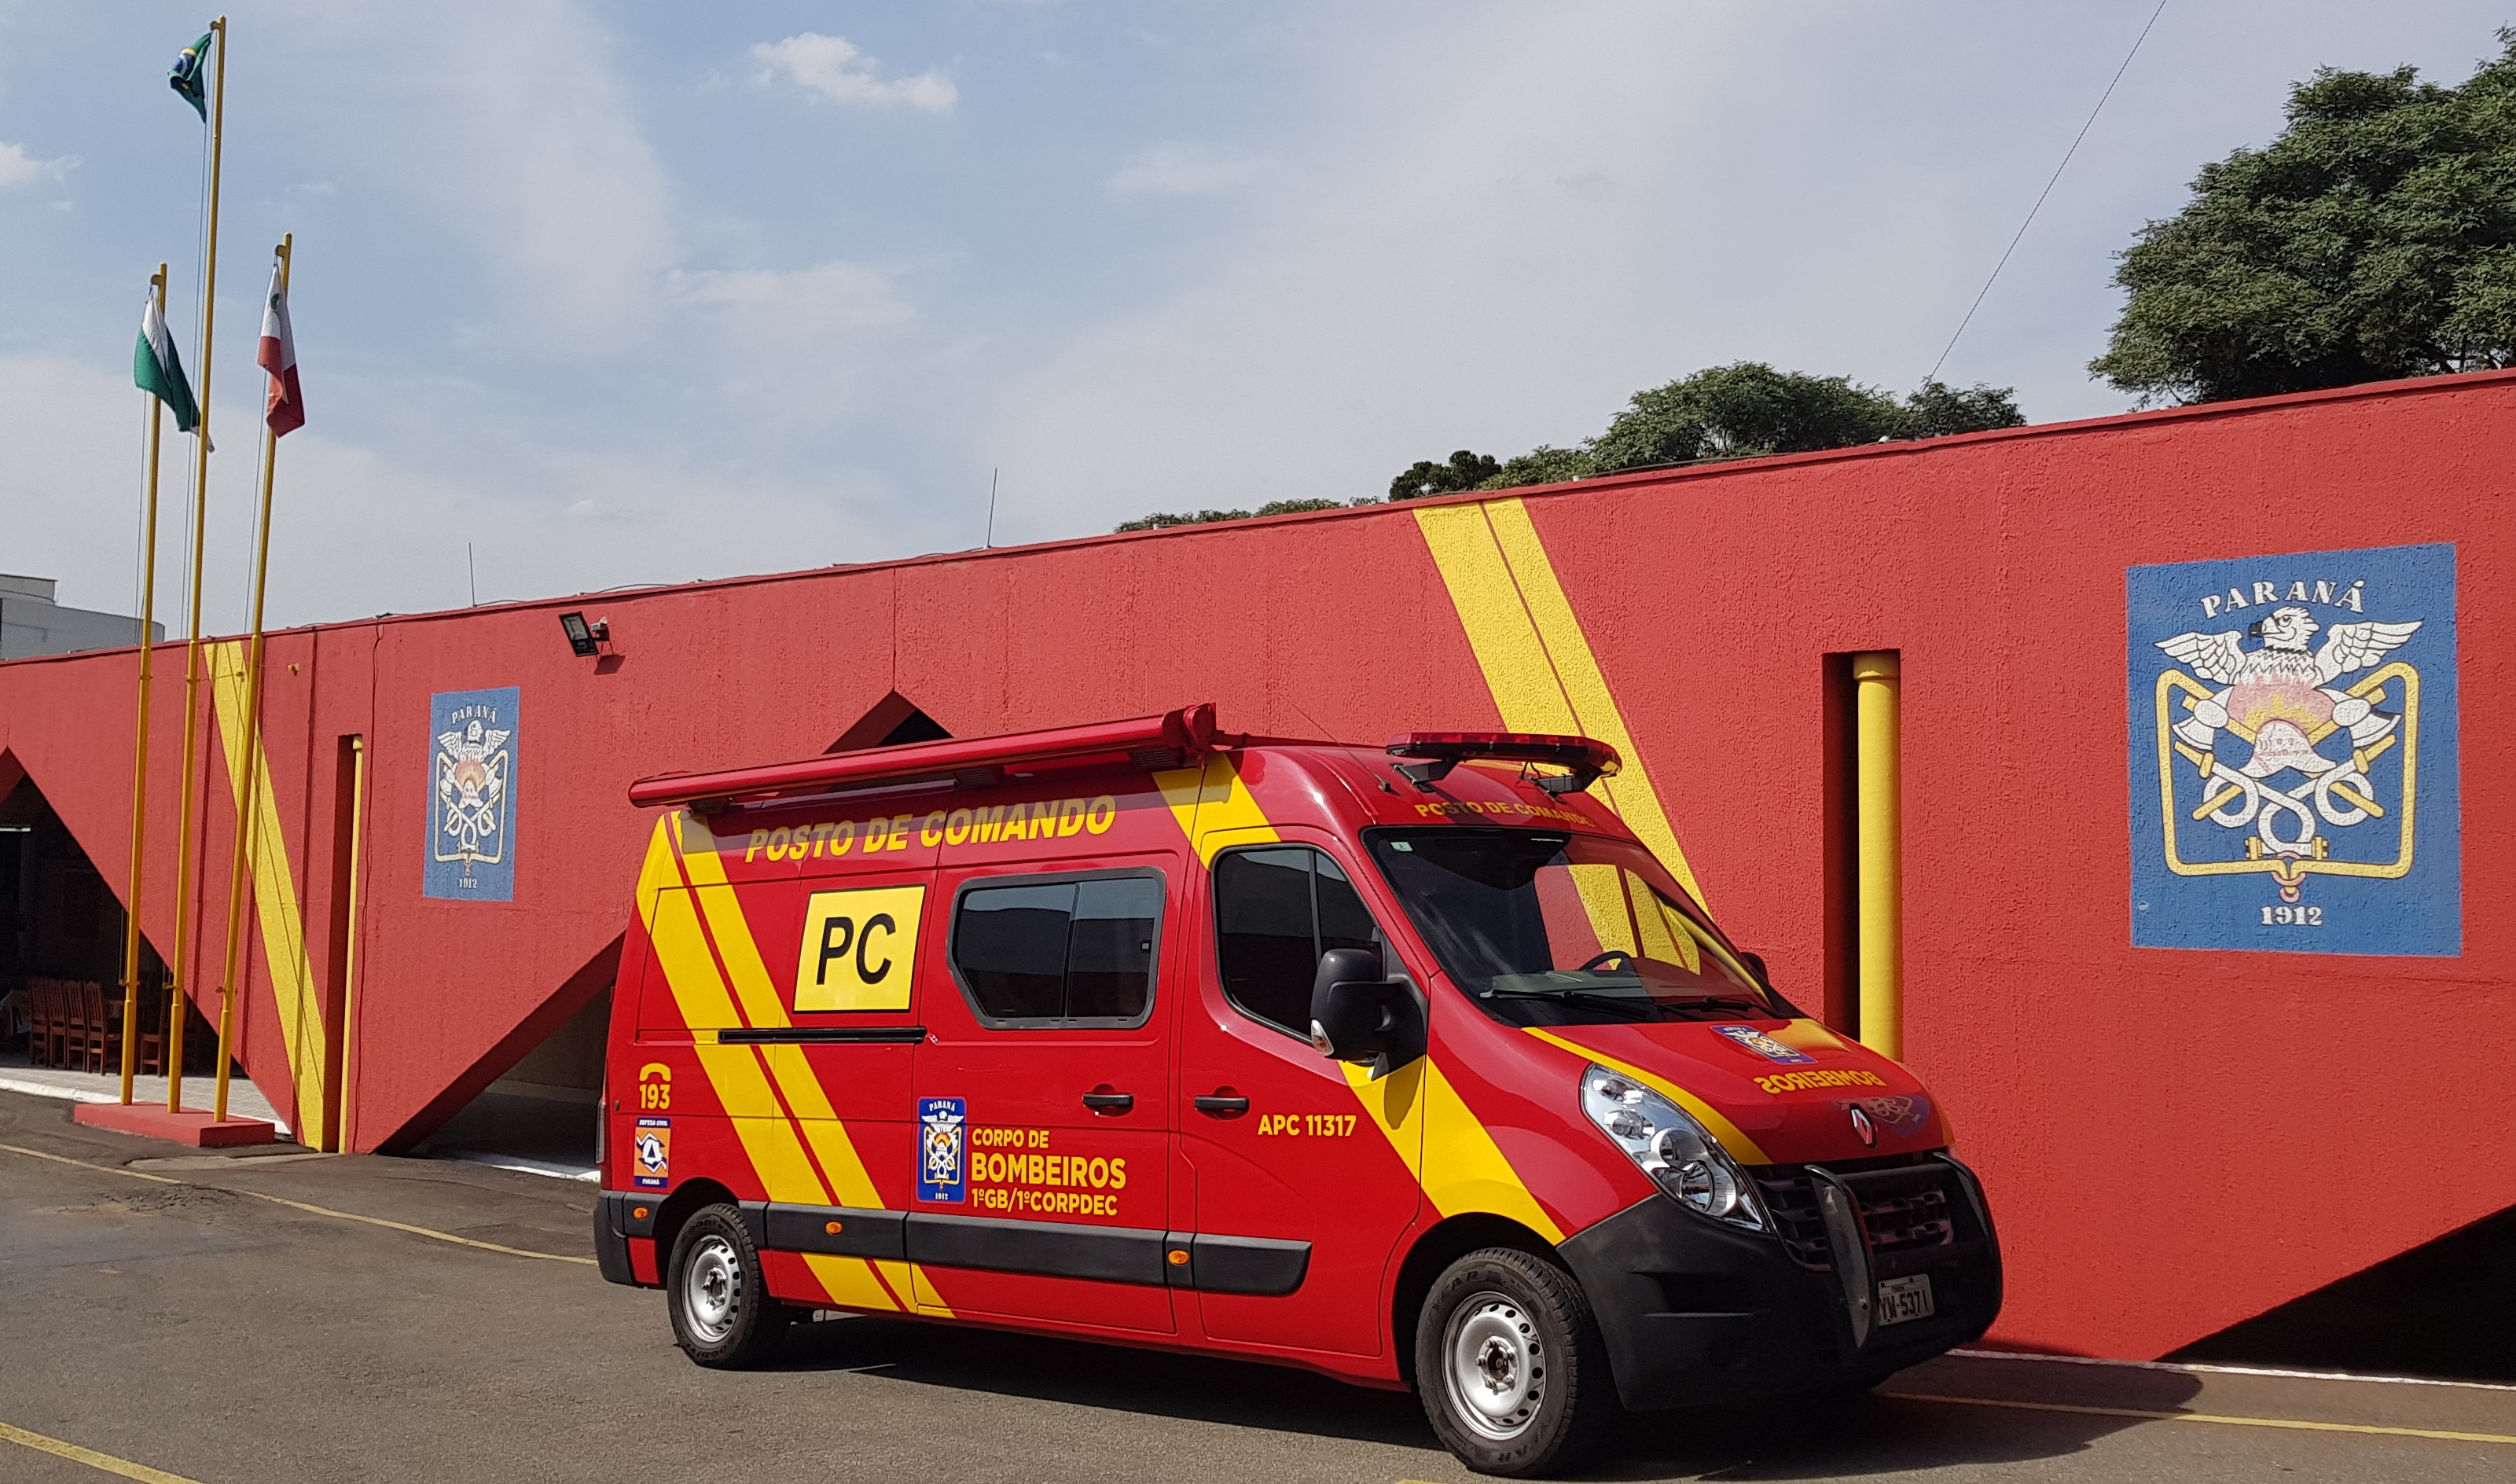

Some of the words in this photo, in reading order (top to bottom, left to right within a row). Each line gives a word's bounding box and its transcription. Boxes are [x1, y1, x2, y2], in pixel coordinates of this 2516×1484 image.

[2201, 580, 2364, 619] PARANÁ
[452, 704, 496, 724] PARANÁ
[1414, 802, 1484, 817] POSTO
[1483, 801, 1514, 814] DE
[745, 820, 854, 863] POSTO
[863, 814, 913, 853] DE
[920, 795, 1116, 847] COMANDO
[458, 877, 478, 888] 1912
[2260, 905, 2323, 926] 1912
[816, 913, 897, 986] PC
[639, 1083, 670, 1110] 193
[928, 1100, 956, 1112] PARANÁ
[1258, 1114, 1300, 1136] APC
[1306, 1115, 1357, 1137] 11317
[972, 1129, 1024, 1148] CORPO
[1028, 1130, 1050, 1148] DE
[972, 1152, 1126, 1189] BOMBEIROS
